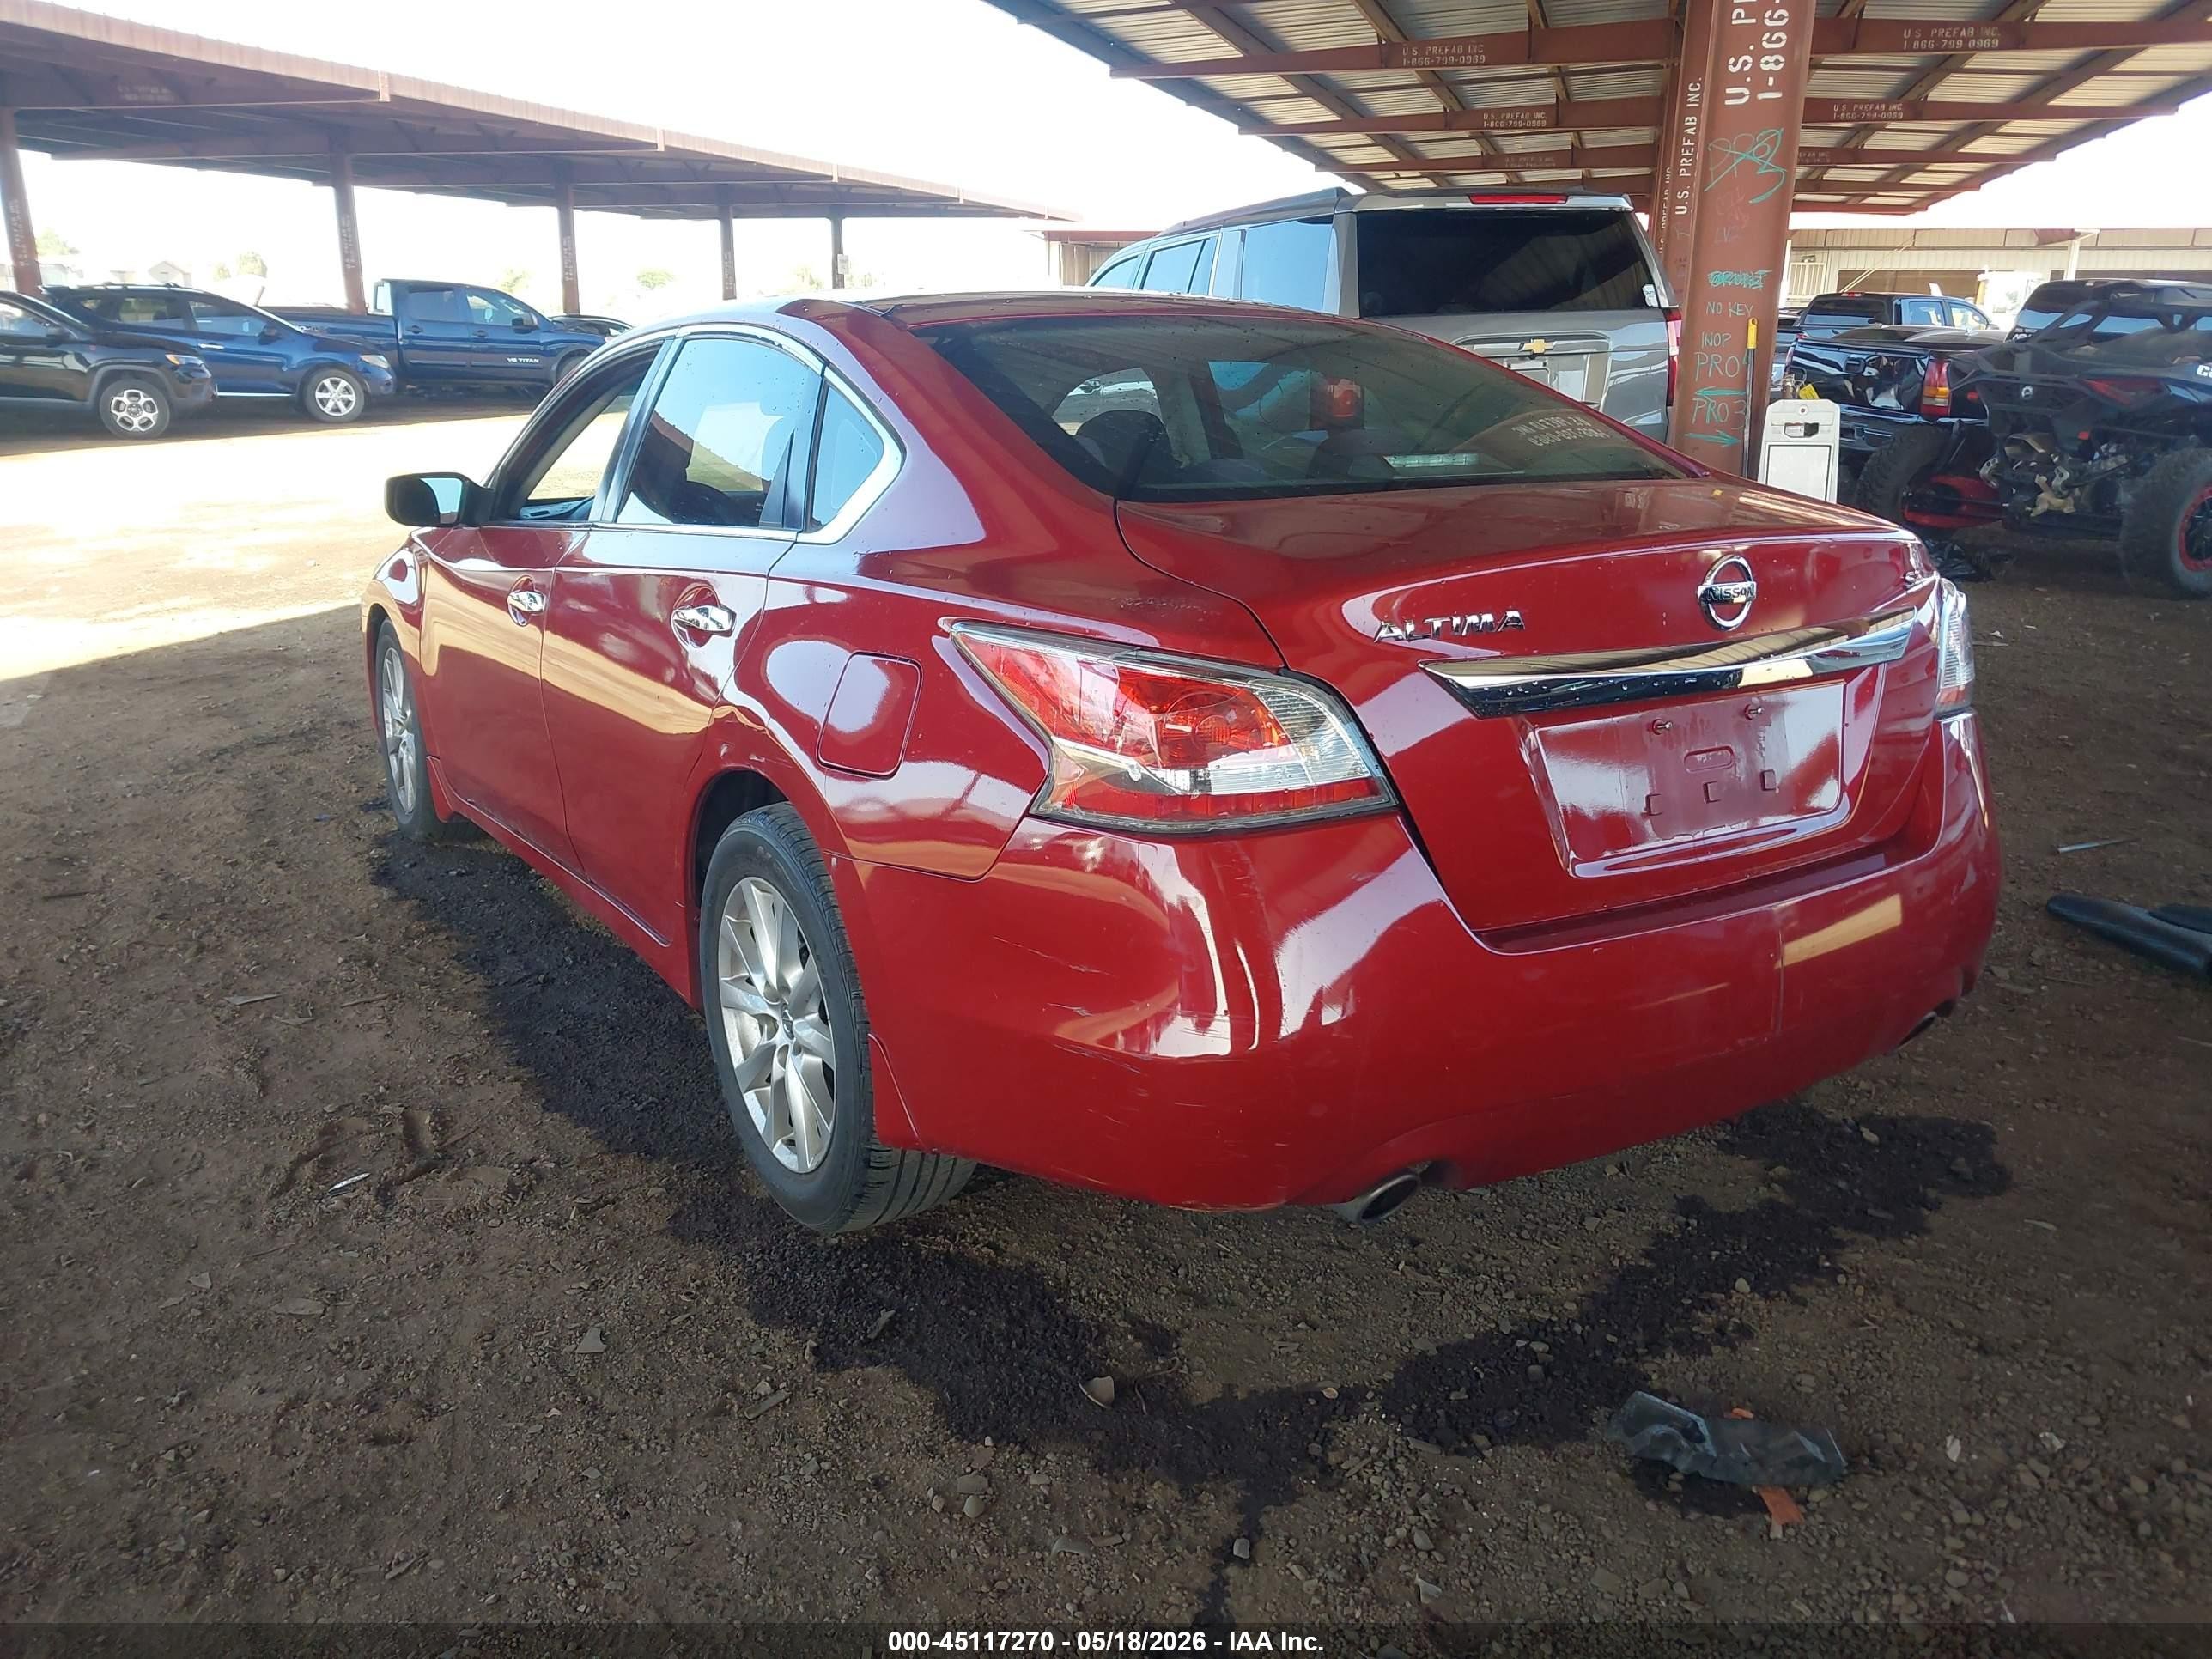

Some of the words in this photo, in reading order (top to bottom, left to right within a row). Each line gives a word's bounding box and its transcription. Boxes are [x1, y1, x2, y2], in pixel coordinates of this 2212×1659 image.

[1731, 0, 1757, 25] P
[1930, 27, 1975, 38] PREFAB
[1402, 54, 1486, 67] 1-866-799-0969
[1425, 44, 1463, 56] PREFAB
[1724, 44, 1754, 106] U.S.
[1686, 76, 1702, 107] INC.
[1853, 103, 1886, 112] PREFAB
[1680, 116, 1698, 177] PREFAB
[1675, 185, 1692, 215] U.S.
[1705, 301, 1723, 316] NO
[1729, 301, 1754, 318] KEY
[1701, 331, 1732, 349] INOP
[1693, 351, 1741, 382] PRO
[1692, 398, 1729, 425] PRO
[1705, 583, 1755, 601] NISSAN
[1374, 610, 1526, 643] ALTIMA
